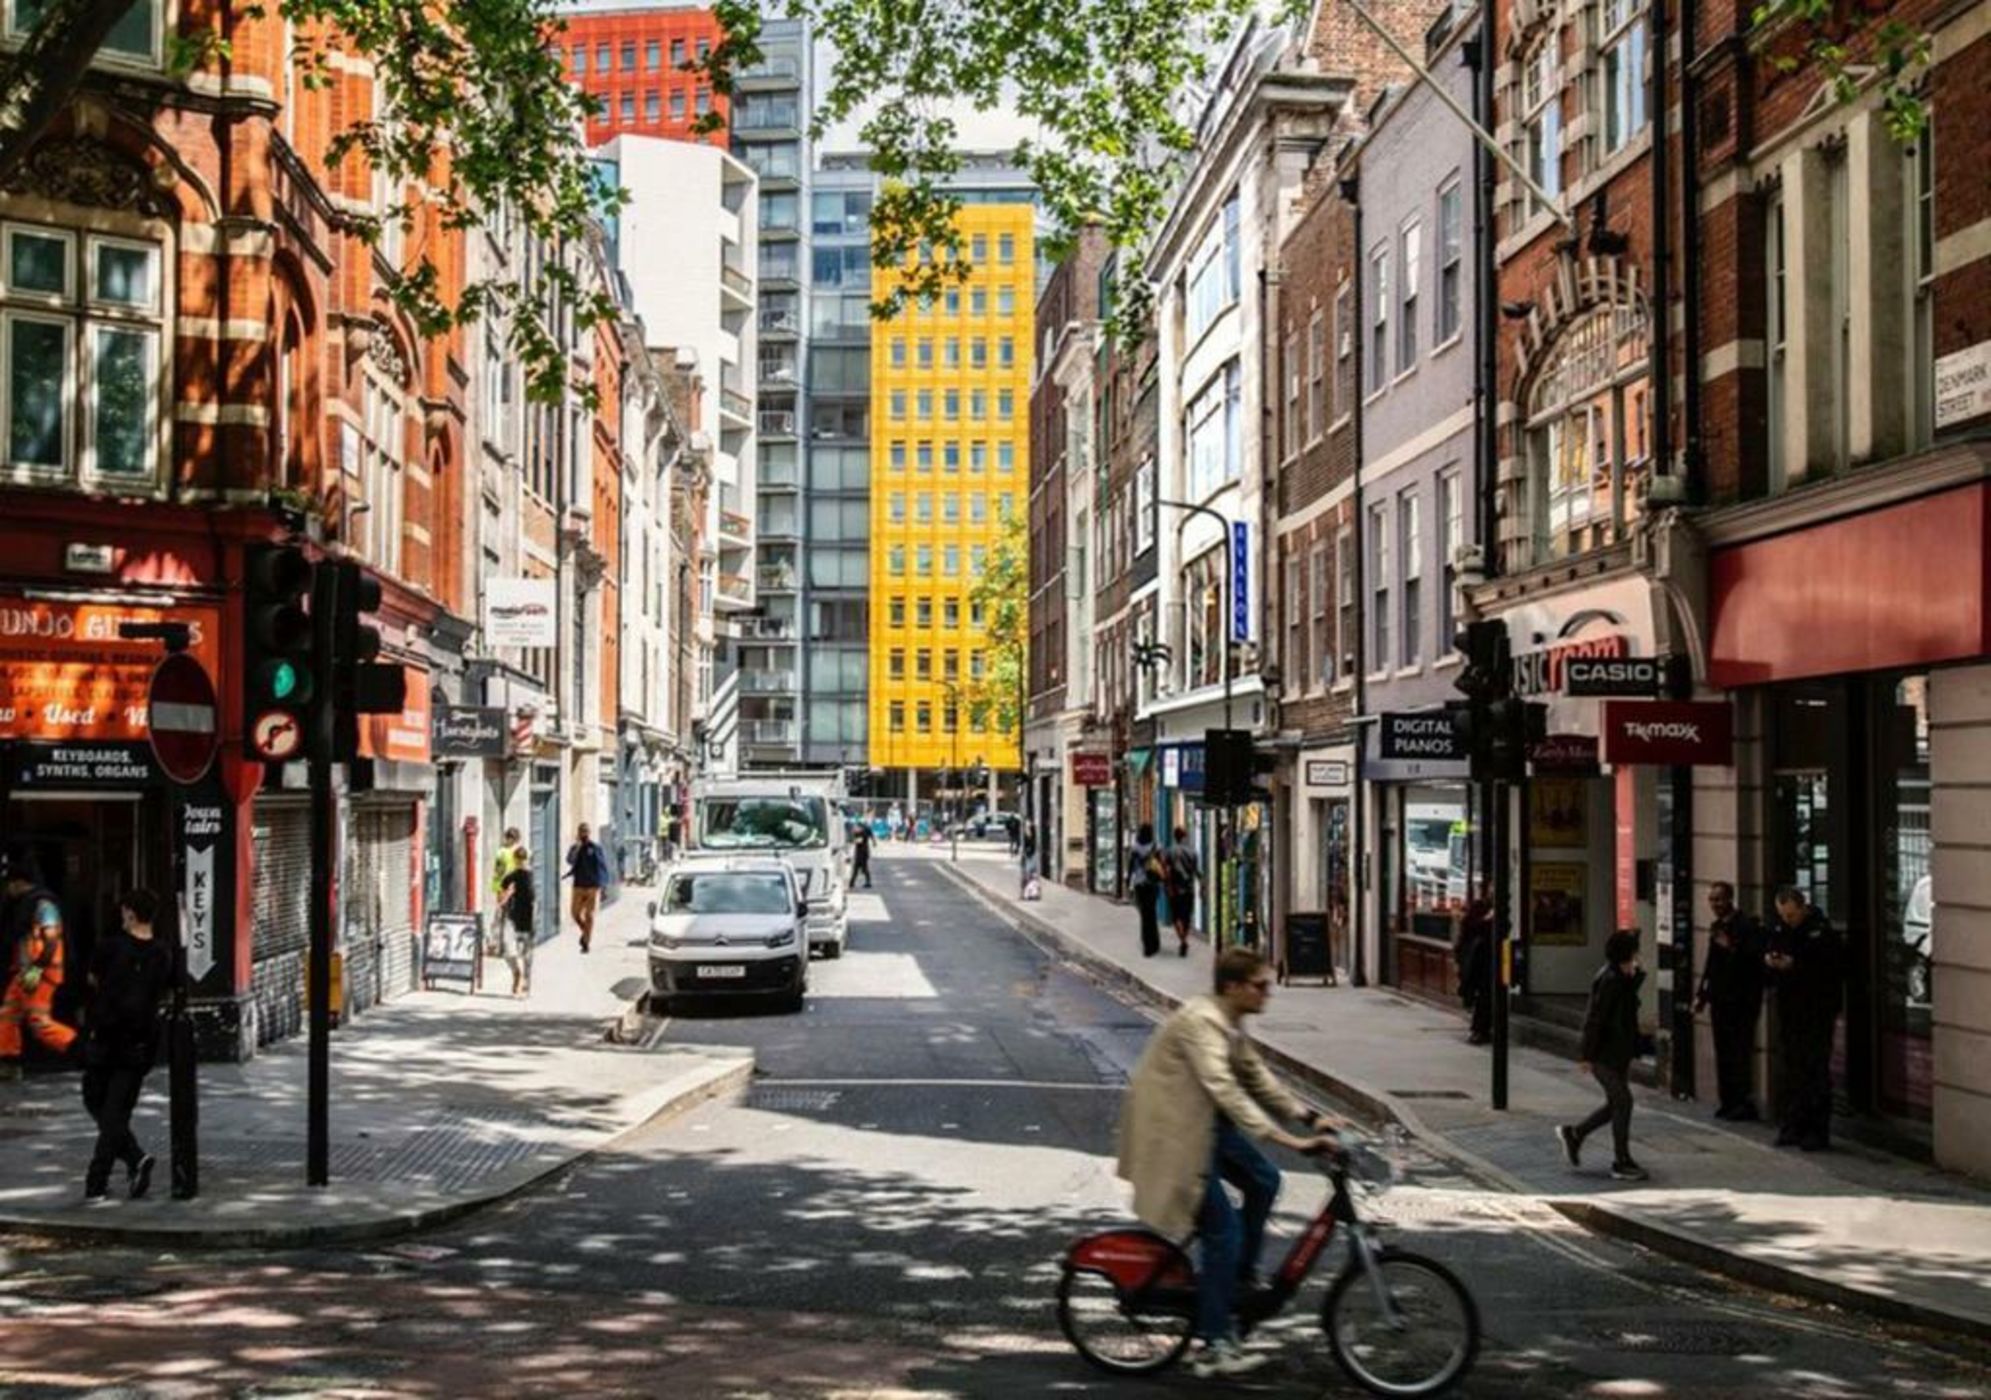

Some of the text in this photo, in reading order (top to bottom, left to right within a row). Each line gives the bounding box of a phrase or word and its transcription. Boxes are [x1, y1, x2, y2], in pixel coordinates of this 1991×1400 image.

[1570, 663, 1654, 681] CASIO
[1393, 719, 1453, 734] DIGITAL
[1395, 738, 1453, 753] PIANOS
[95, 765, 148, 778] ORGANS
[193, 871, 206, 949] KEYS
